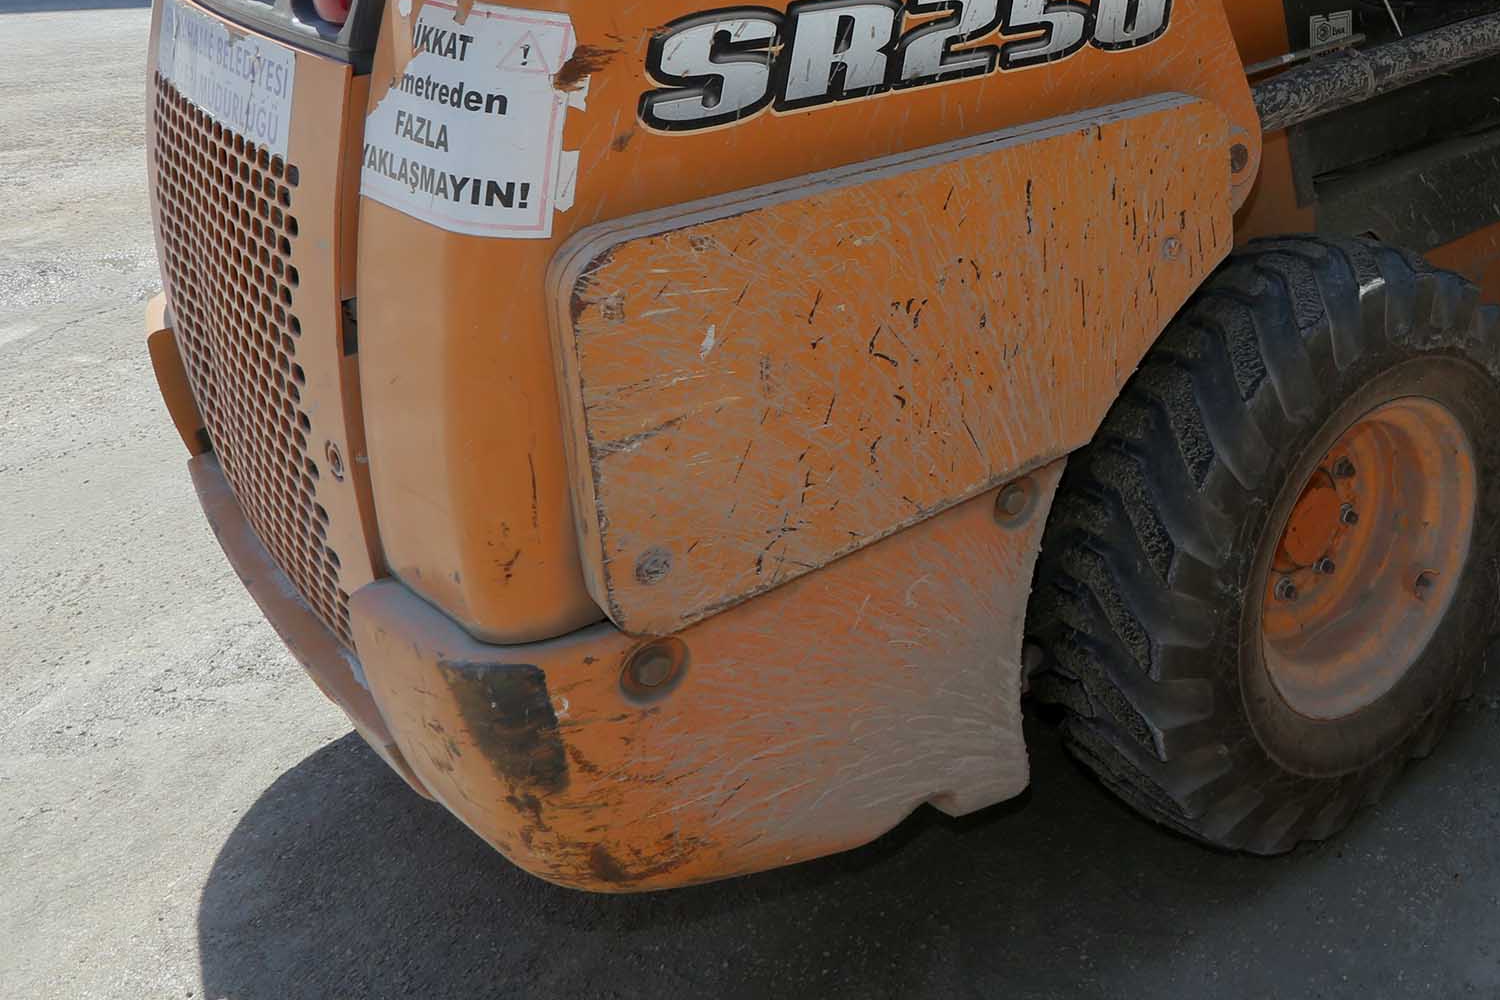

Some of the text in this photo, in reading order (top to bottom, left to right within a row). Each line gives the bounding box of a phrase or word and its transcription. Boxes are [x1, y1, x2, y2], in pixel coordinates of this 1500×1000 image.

[413, 18, 474, 62] İKKAT
[400, 71, 508, 115] metreden
[395, 110, 449, 152] FAZLA
